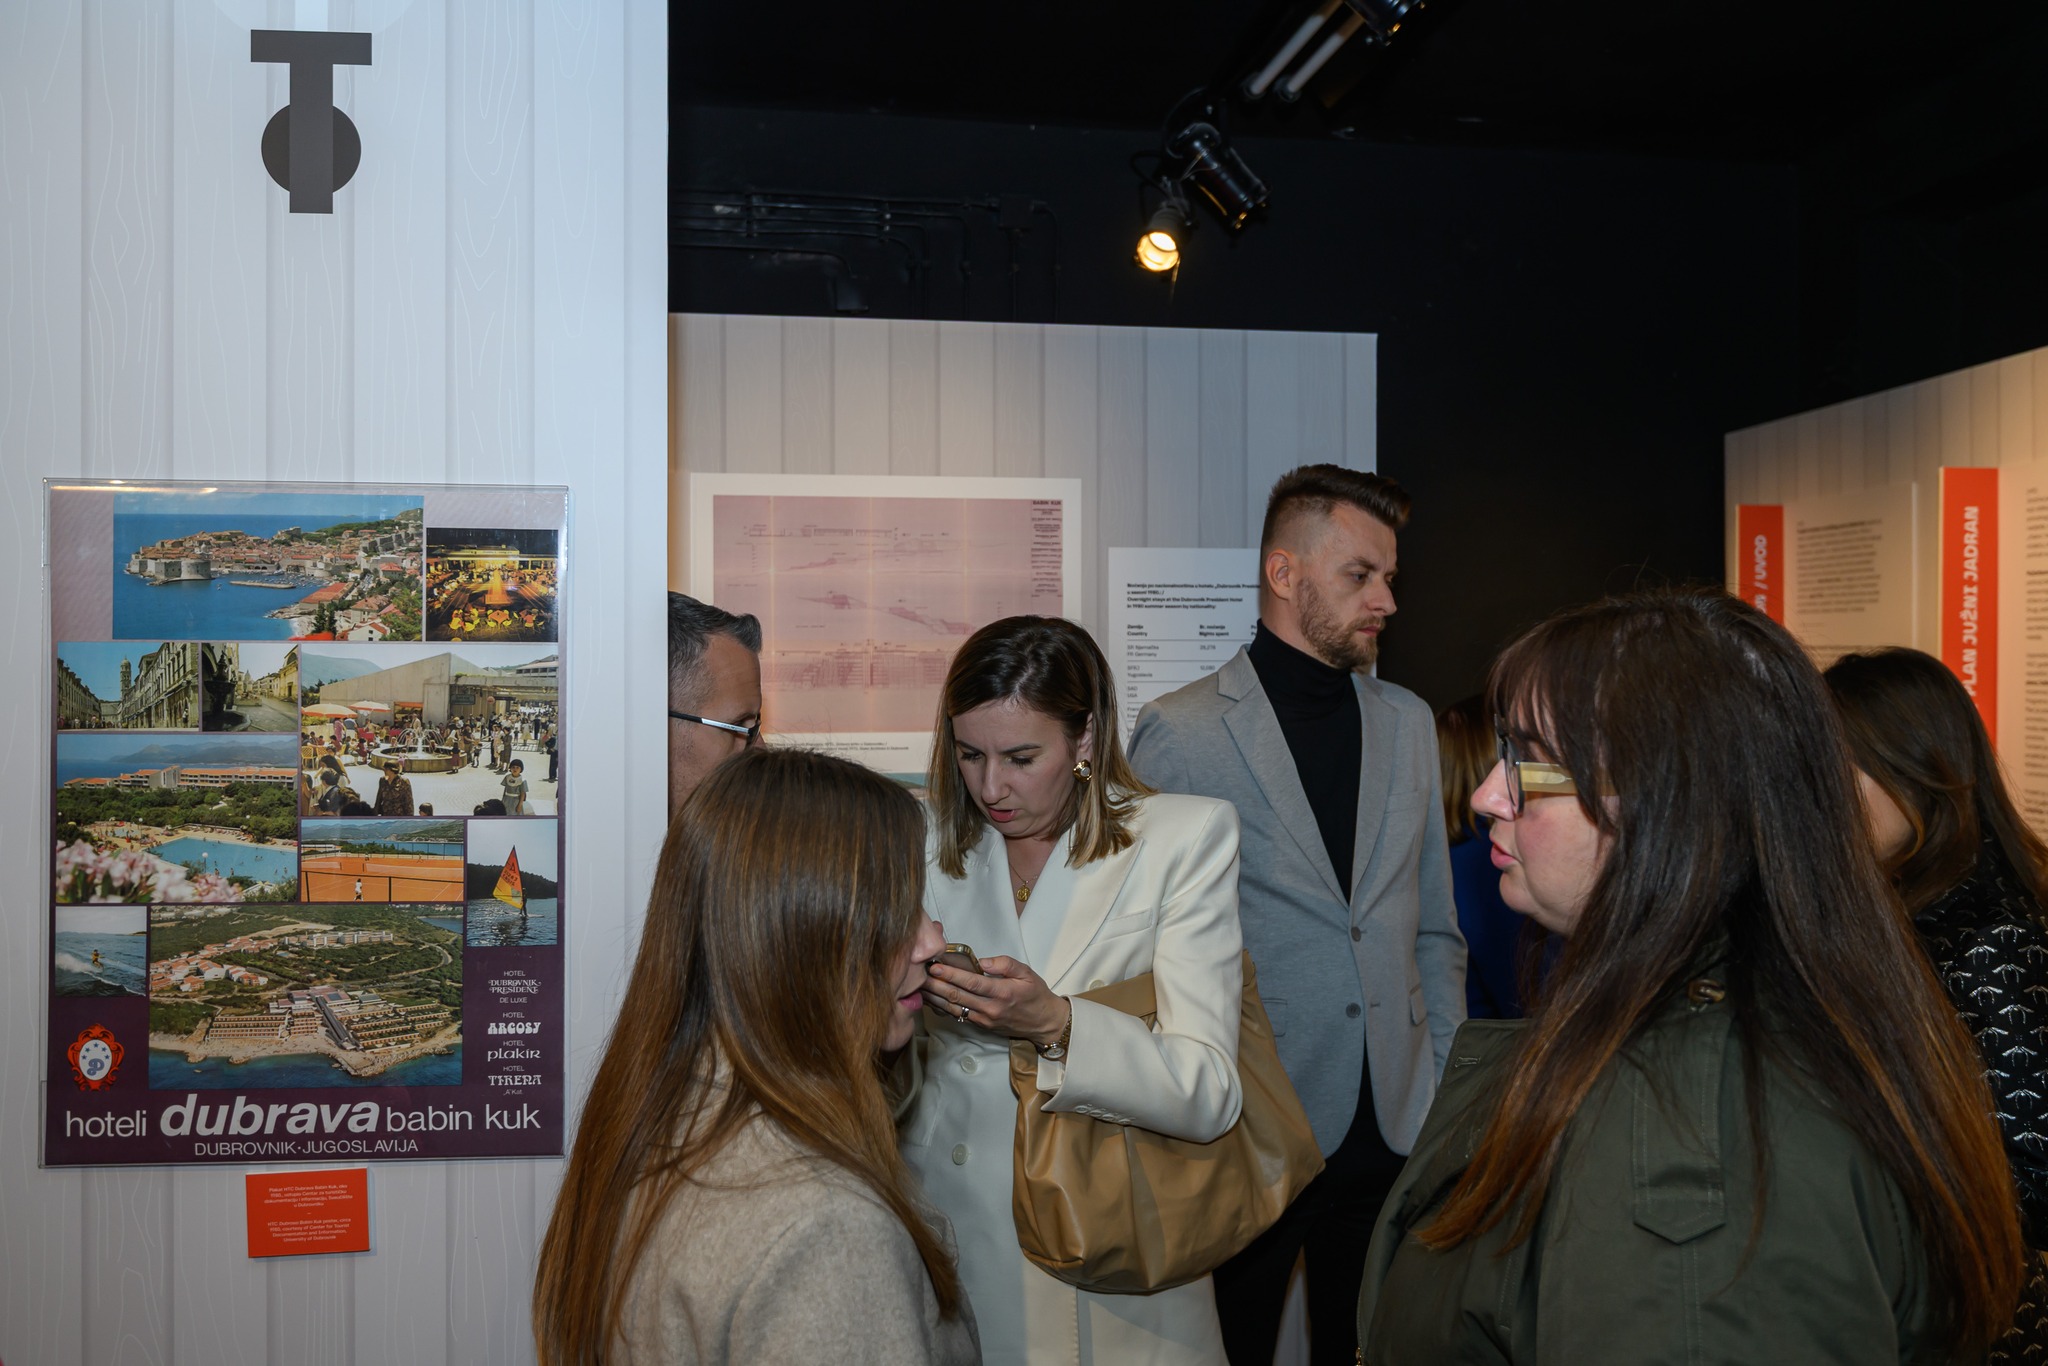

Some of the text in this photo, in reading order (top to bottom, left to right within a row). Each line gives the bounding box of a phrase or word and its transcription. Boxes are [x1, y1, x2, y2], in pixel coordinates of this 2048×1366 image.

[1963, 506, 1979, 581] JADRAN
[1960, 585, 1978, 645] JUŽNI
[489, 986, 539, 994] PRESIDENT
[66, 1093, 541, 1137] hoteli dubrava babin kuk
